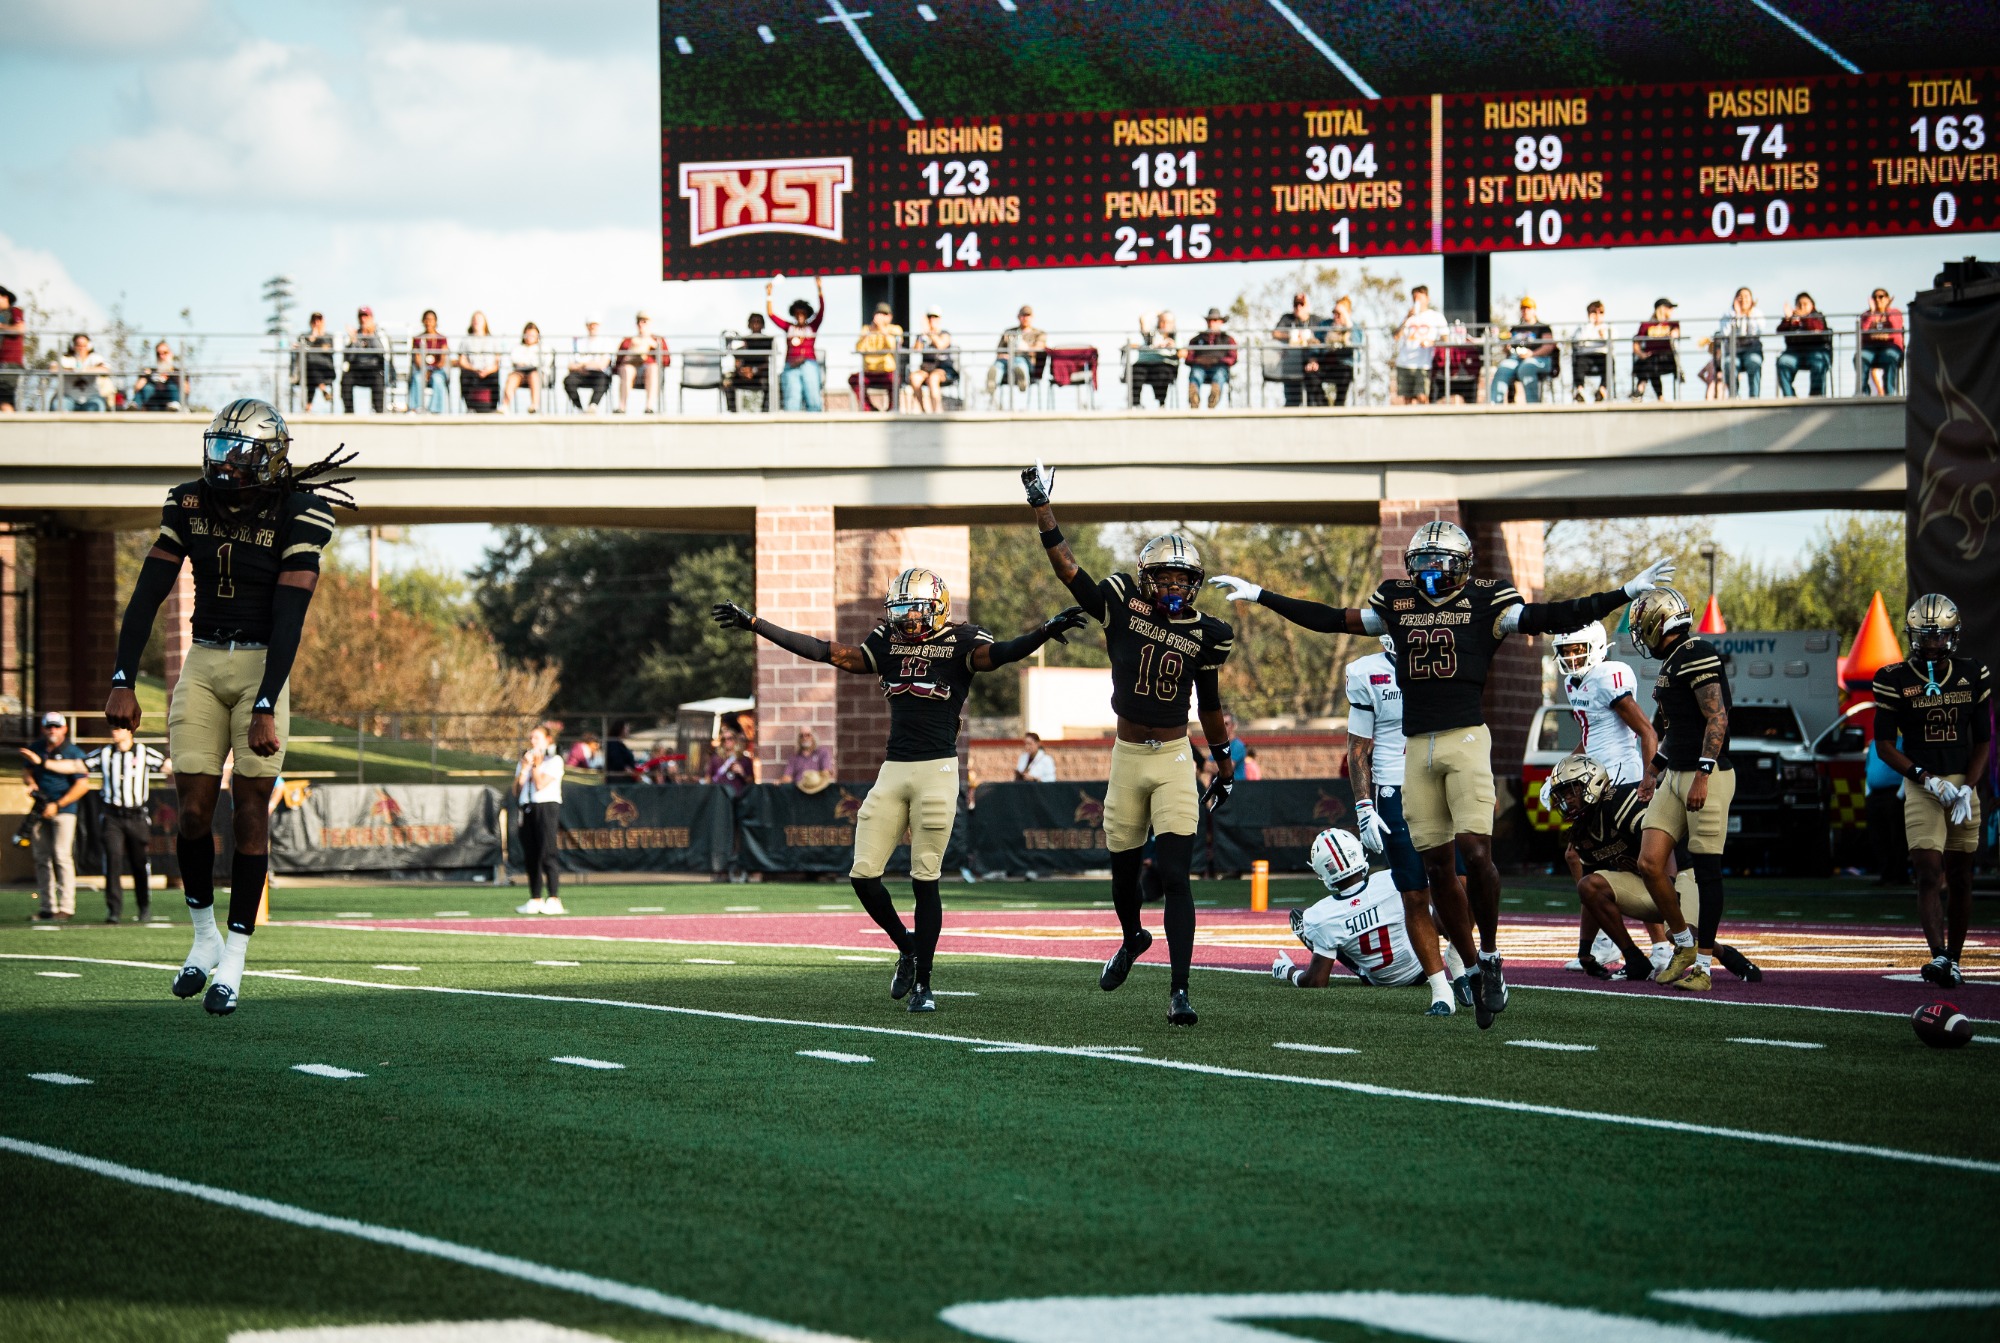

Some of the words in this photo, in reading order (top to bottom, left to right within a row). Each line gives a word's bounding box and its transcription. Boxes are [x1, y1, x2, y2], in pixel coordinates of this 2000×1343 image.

[1708, 87, 1810, 119] PASSING
[1907, 79, 1978, 108] TOTAL
[1303, 109, 1369, 138] TOTAL
[1484, 99, 1587, 130] RUSHING
[906, 125, 1003, 155] RUSHING
[1113, 116, 1208, 147] PASSING
[1736, 123, 1787, 162] 74
[1910, 114, 1985, 152] 163
[1131, 150, 1197, 188] 181
[1305, 142, 1378, 181] 304
[1514, 135, 1563, 172] 89
[1872, 153, 2000, 185] TURNOVER
[921, 160, 990, 196] 123
[1466, 175, 1508, 205] 1ST
[1516, 172, 1603, 202] DOWNS
[1699, 162, 1819, 194] PENALTIES
[685, 163, 846, 236] TXST
[893, 199, 932, 227] 1ST
[938, 195, 1020, 225] DOWNS
[1105, 188, 1217, 219] PENALTIES
[1271, 180, 1402, 212] TURNOVERS
[1933, 191, 1957, 228] 0
[1332, 217, 1350, 253] 1
[1515, 208, 1563, 246] 10
[935, 231, 981, 267] 14
[217, 542, 235, 598] 1
[1399, 612, 1435, 626] TEXAS
[1434, 610, 1472, 625] STATE
[889, 644, 922, 656] TEXAS
[921, 644, 954, 658] STATE
[1128, 615, 1167, 642] TEXAS
[1165, 632, 1201, 658] STATE
[1713, 638, 1776, 654] COUNTY
[1407, 627, 1458, 679] 23
[1134, 643, 1184, 701] 18
[1612, 671, 1623, 690] 11
[1381, 688, 1403, 702] SOUT
[1911, 694, 1943, 708] TEXAS
[1943, 690, 1972, 705] STATE
[1924, 707, 1958, 741] 21
[556, 828, 625, 849] TEXAS
[625, 827, 690, 848] STATE
[783, 825, 855, 847] TEXAS
[1022, 828, 1094, 850] TEXAS
[1345, 905, 1380, 937] SCOTT
[1358, 925, 1394, 973] 9
